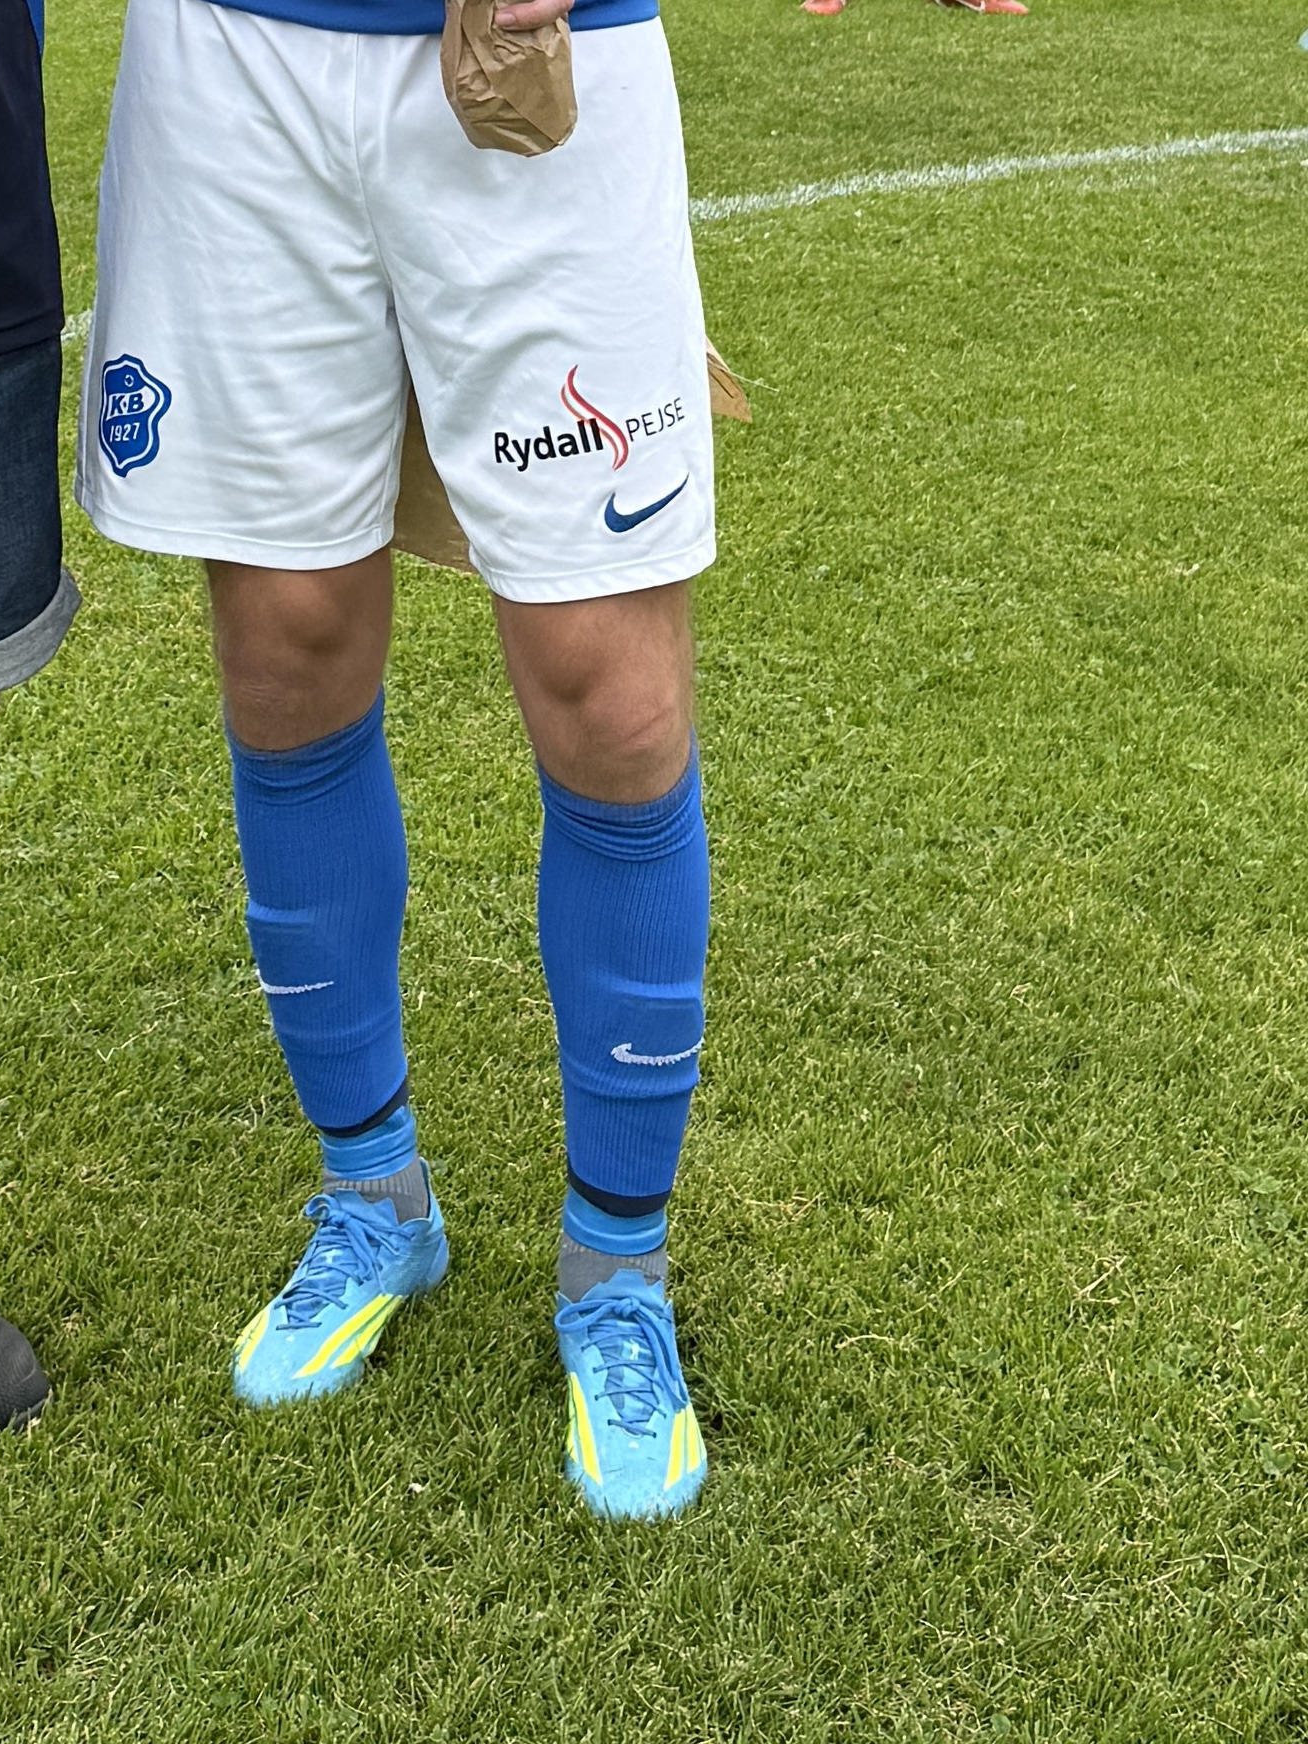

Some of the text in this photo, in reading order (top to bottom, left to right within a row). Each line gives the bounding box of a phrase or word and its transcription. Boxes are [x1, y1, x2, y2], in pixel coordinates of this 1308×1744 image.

[109, 422, 141, 443] 1927
[494, 396, 686, 472] Rydall PEJSE
